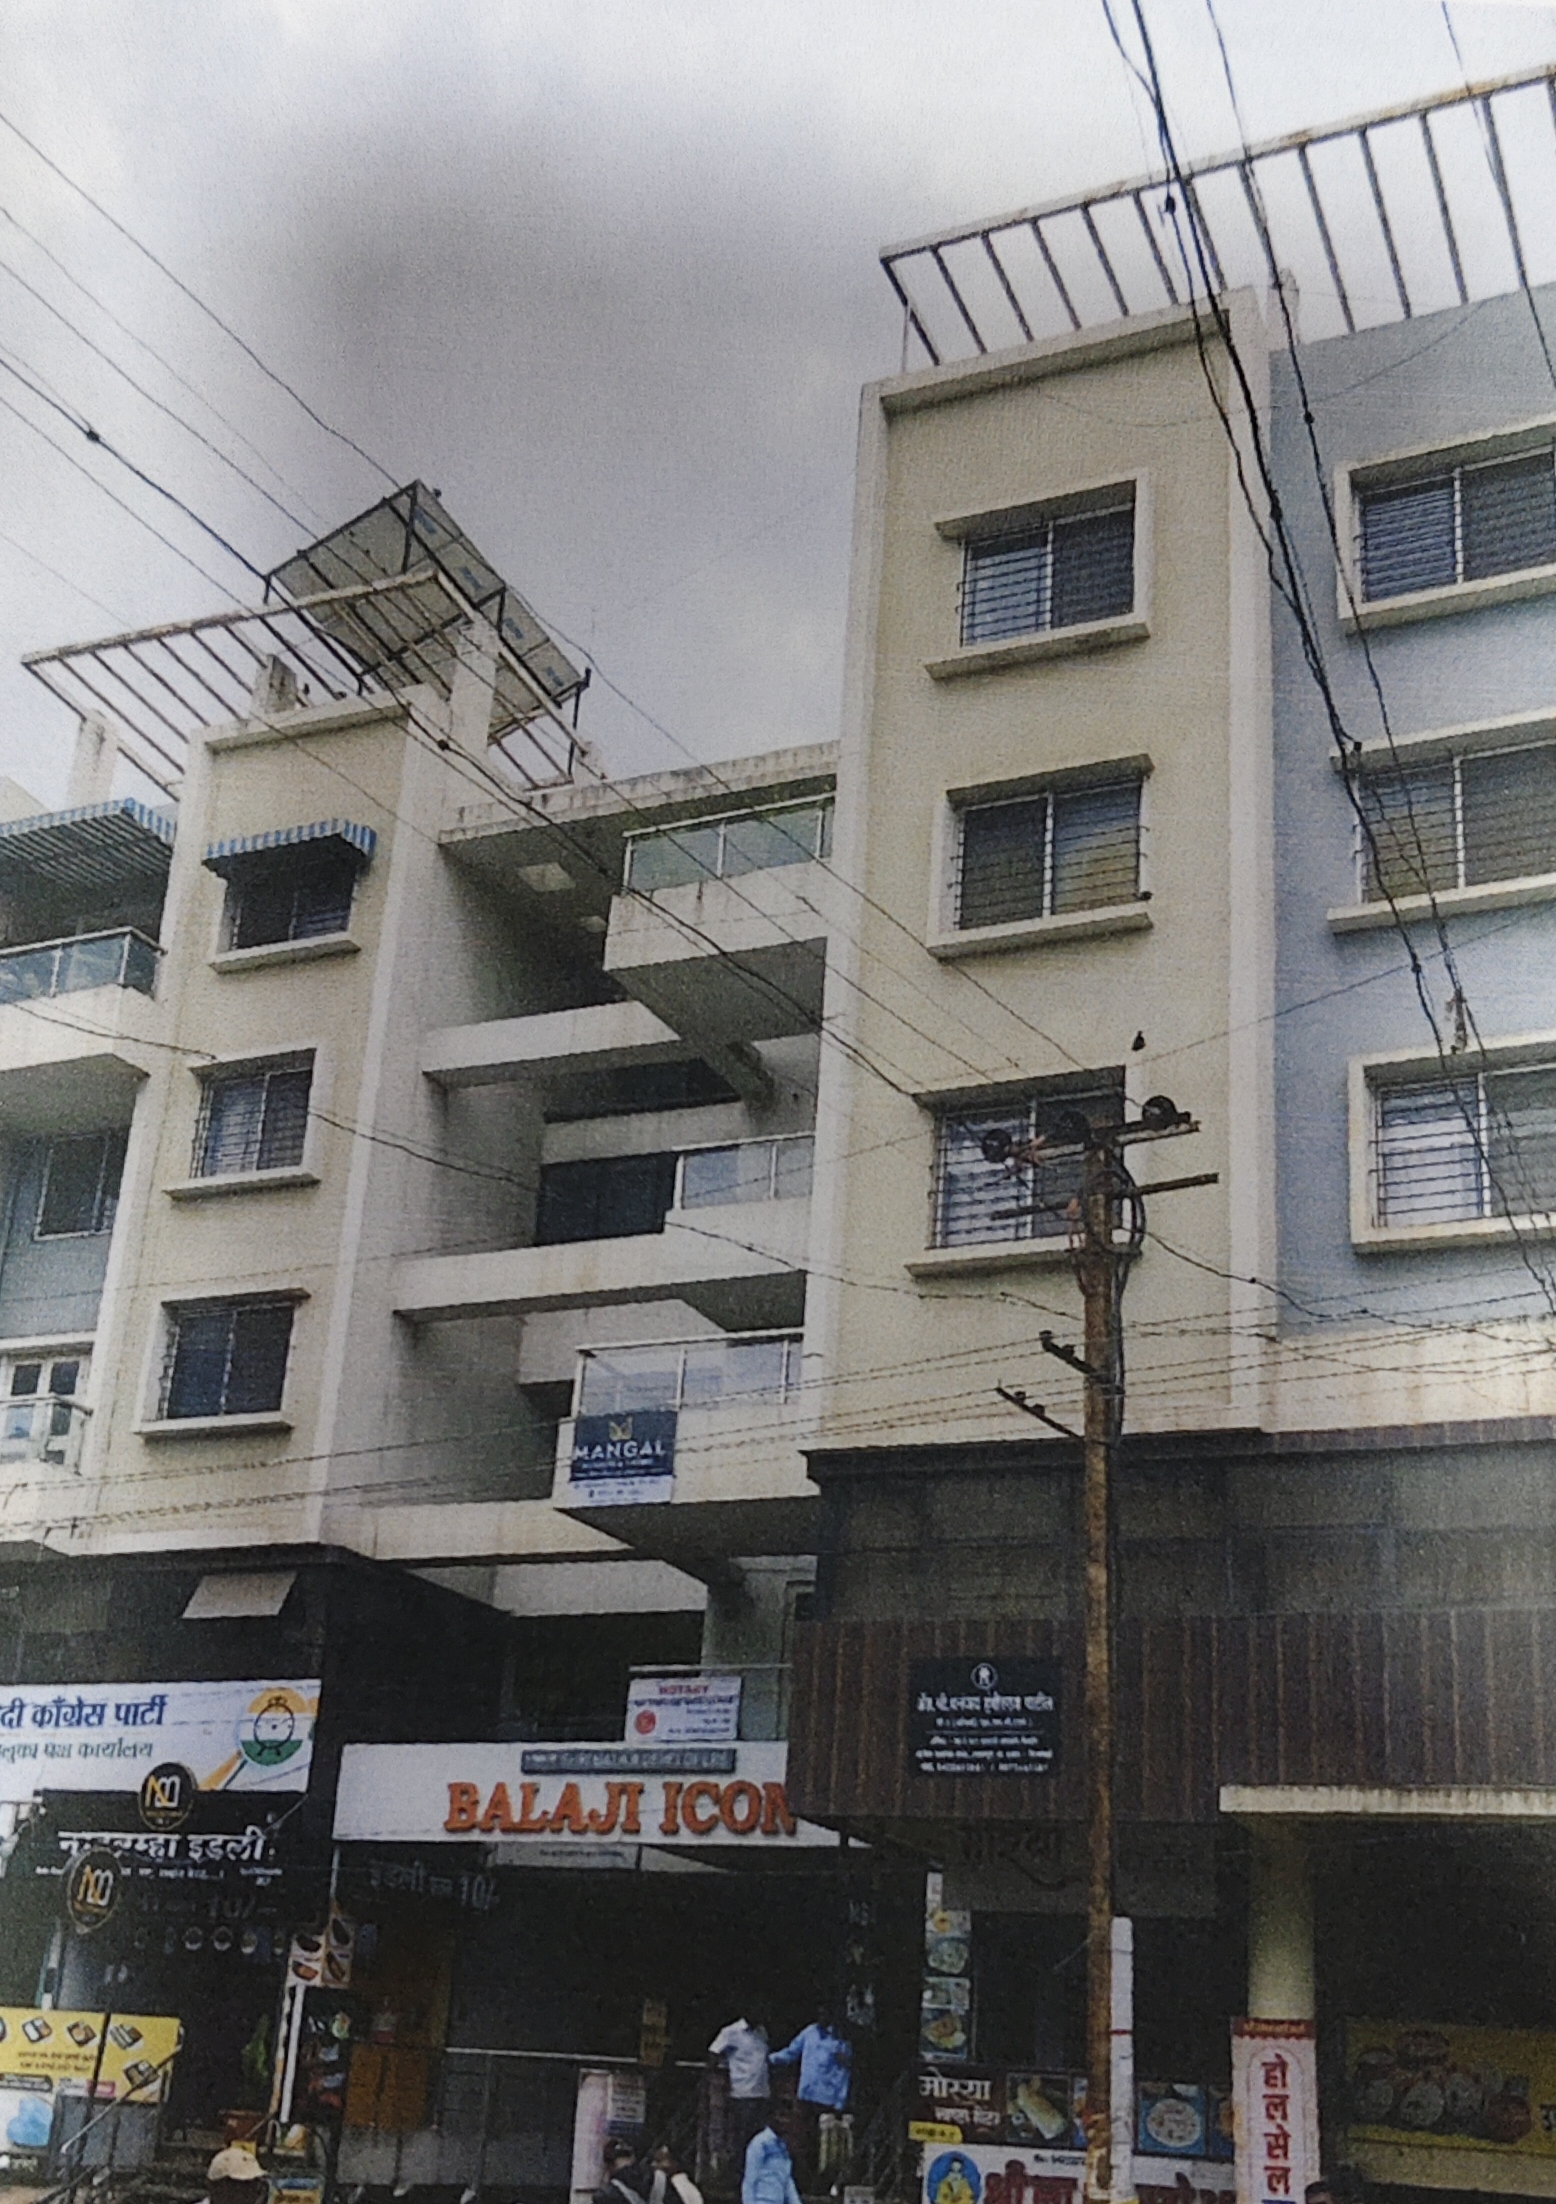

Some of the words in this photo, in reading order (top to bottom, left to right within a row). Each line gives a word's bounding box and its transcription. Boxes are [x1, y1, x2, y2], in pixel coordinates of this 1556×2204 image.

[575, 1439, 667, 1460] MANGAL
[115, 1694, 168, 1726] पार्टी
[445, 1781, 645, 1836] BALAJI
[659, 1780, 799, 1836] ICON
